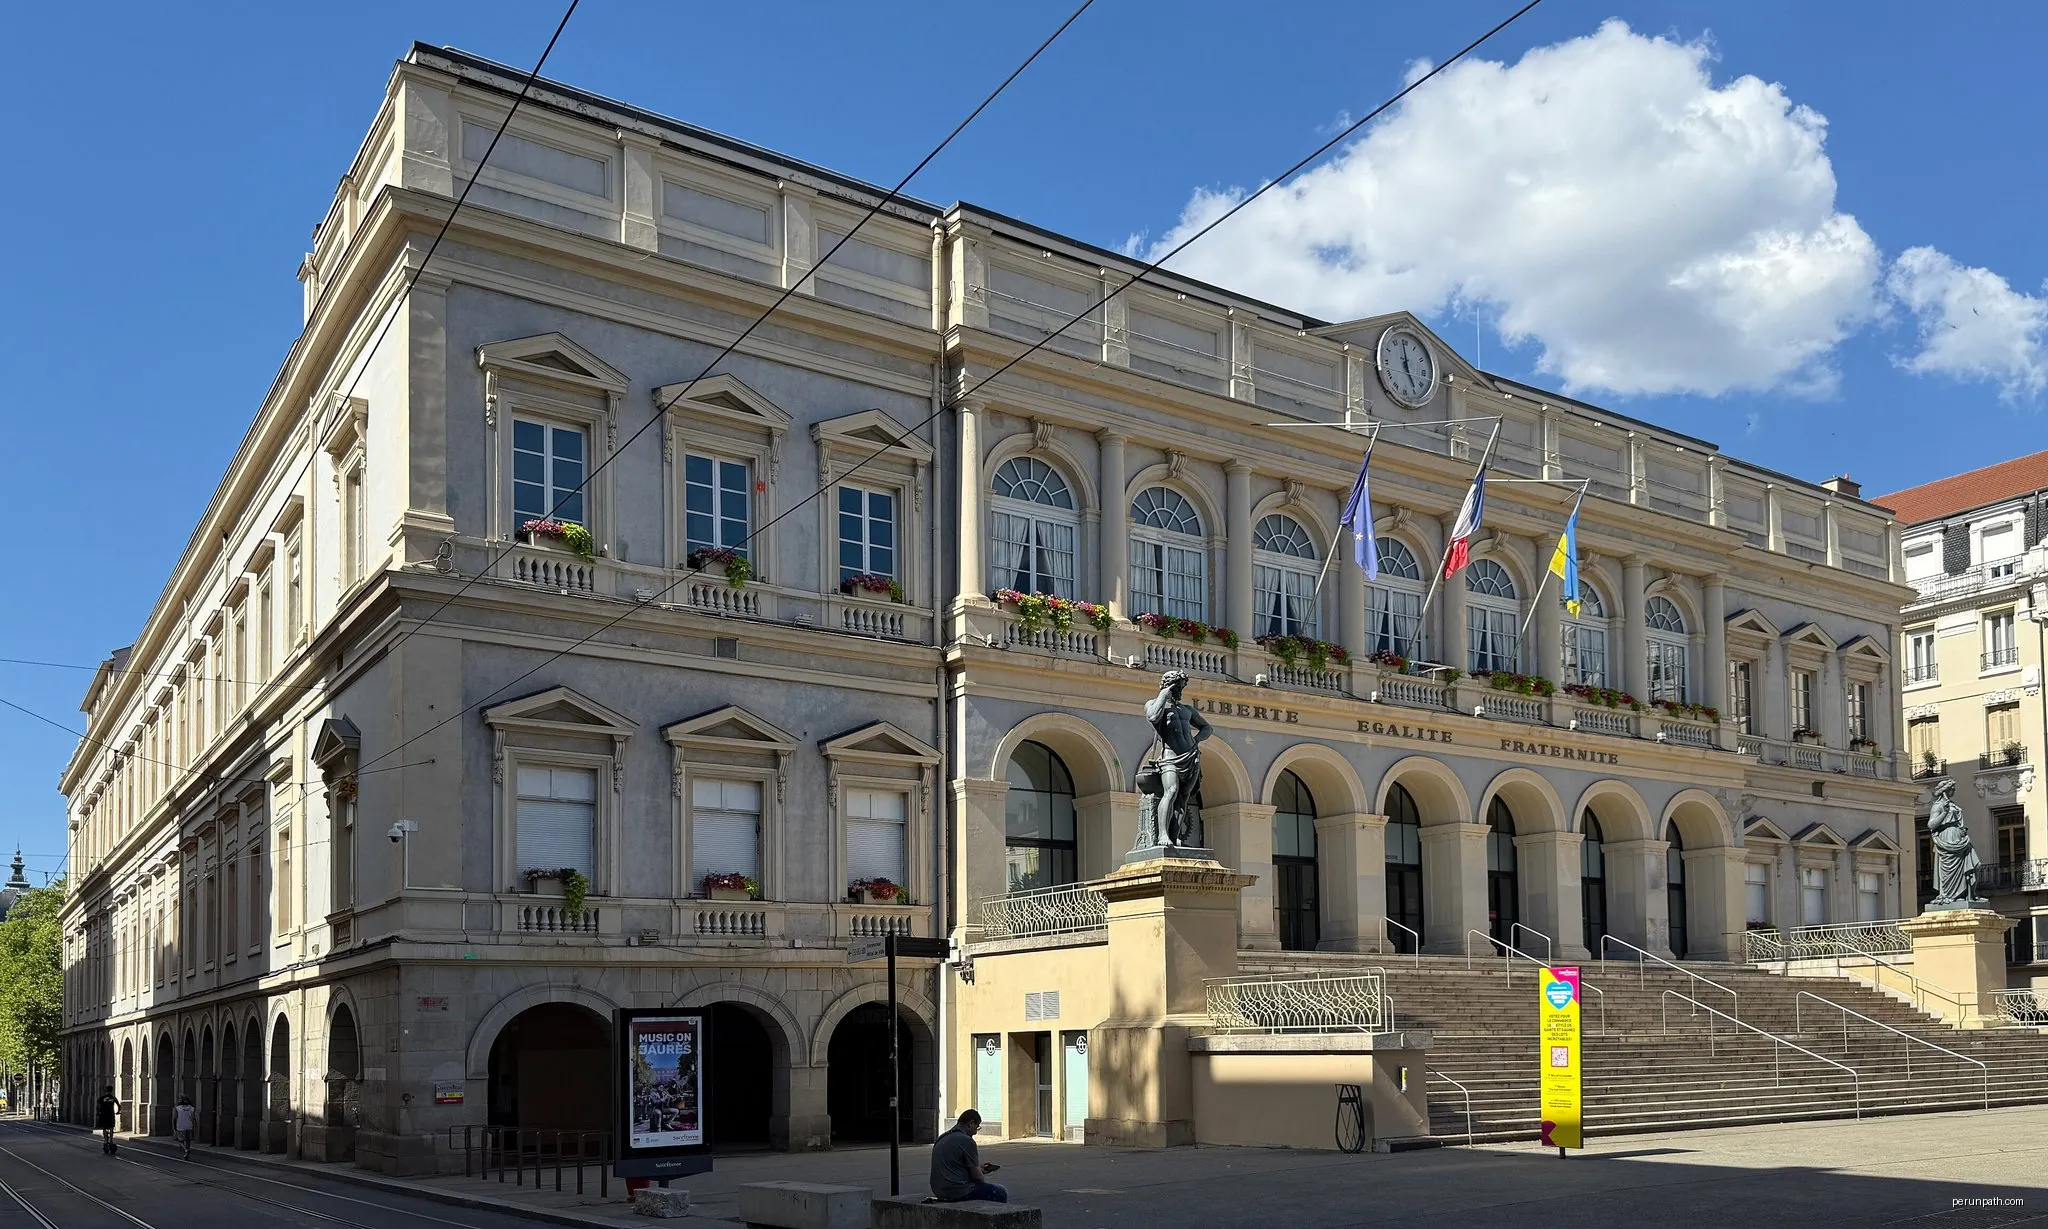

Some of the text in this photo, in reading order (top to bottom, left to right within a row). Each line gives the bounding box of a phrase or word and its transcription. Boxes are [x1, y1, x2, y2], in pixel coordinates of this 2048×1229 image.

[1192, 698, 1299, 723] LIBERTE
[1357, 720, 1453, 743] EGALITE
[1500, 739, 1619, 764] FRATERNITE
[639, 1033, 691, 1042] MUSIC ON
